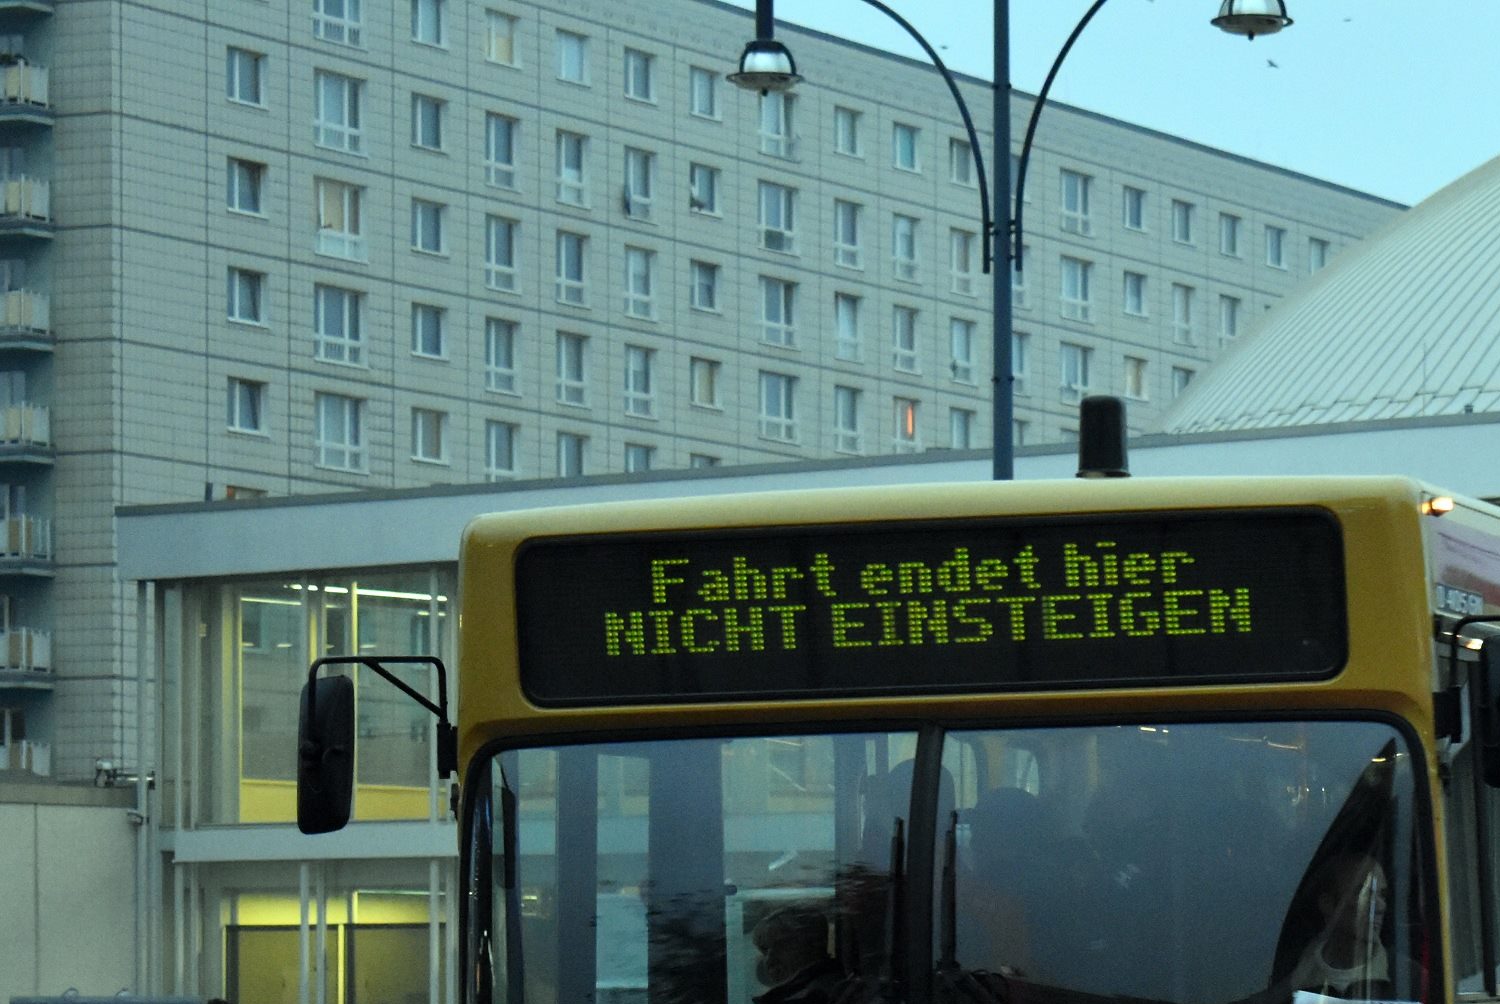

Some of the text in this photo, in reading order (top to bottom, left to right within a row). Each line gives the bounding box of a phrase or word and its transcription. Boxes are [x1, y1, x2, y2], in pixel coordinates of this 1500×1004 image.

[651, 541, 1195, 603] Fahrt endet hier
[604, 587, 1251, 656] NICHT EINSTEIGEN
